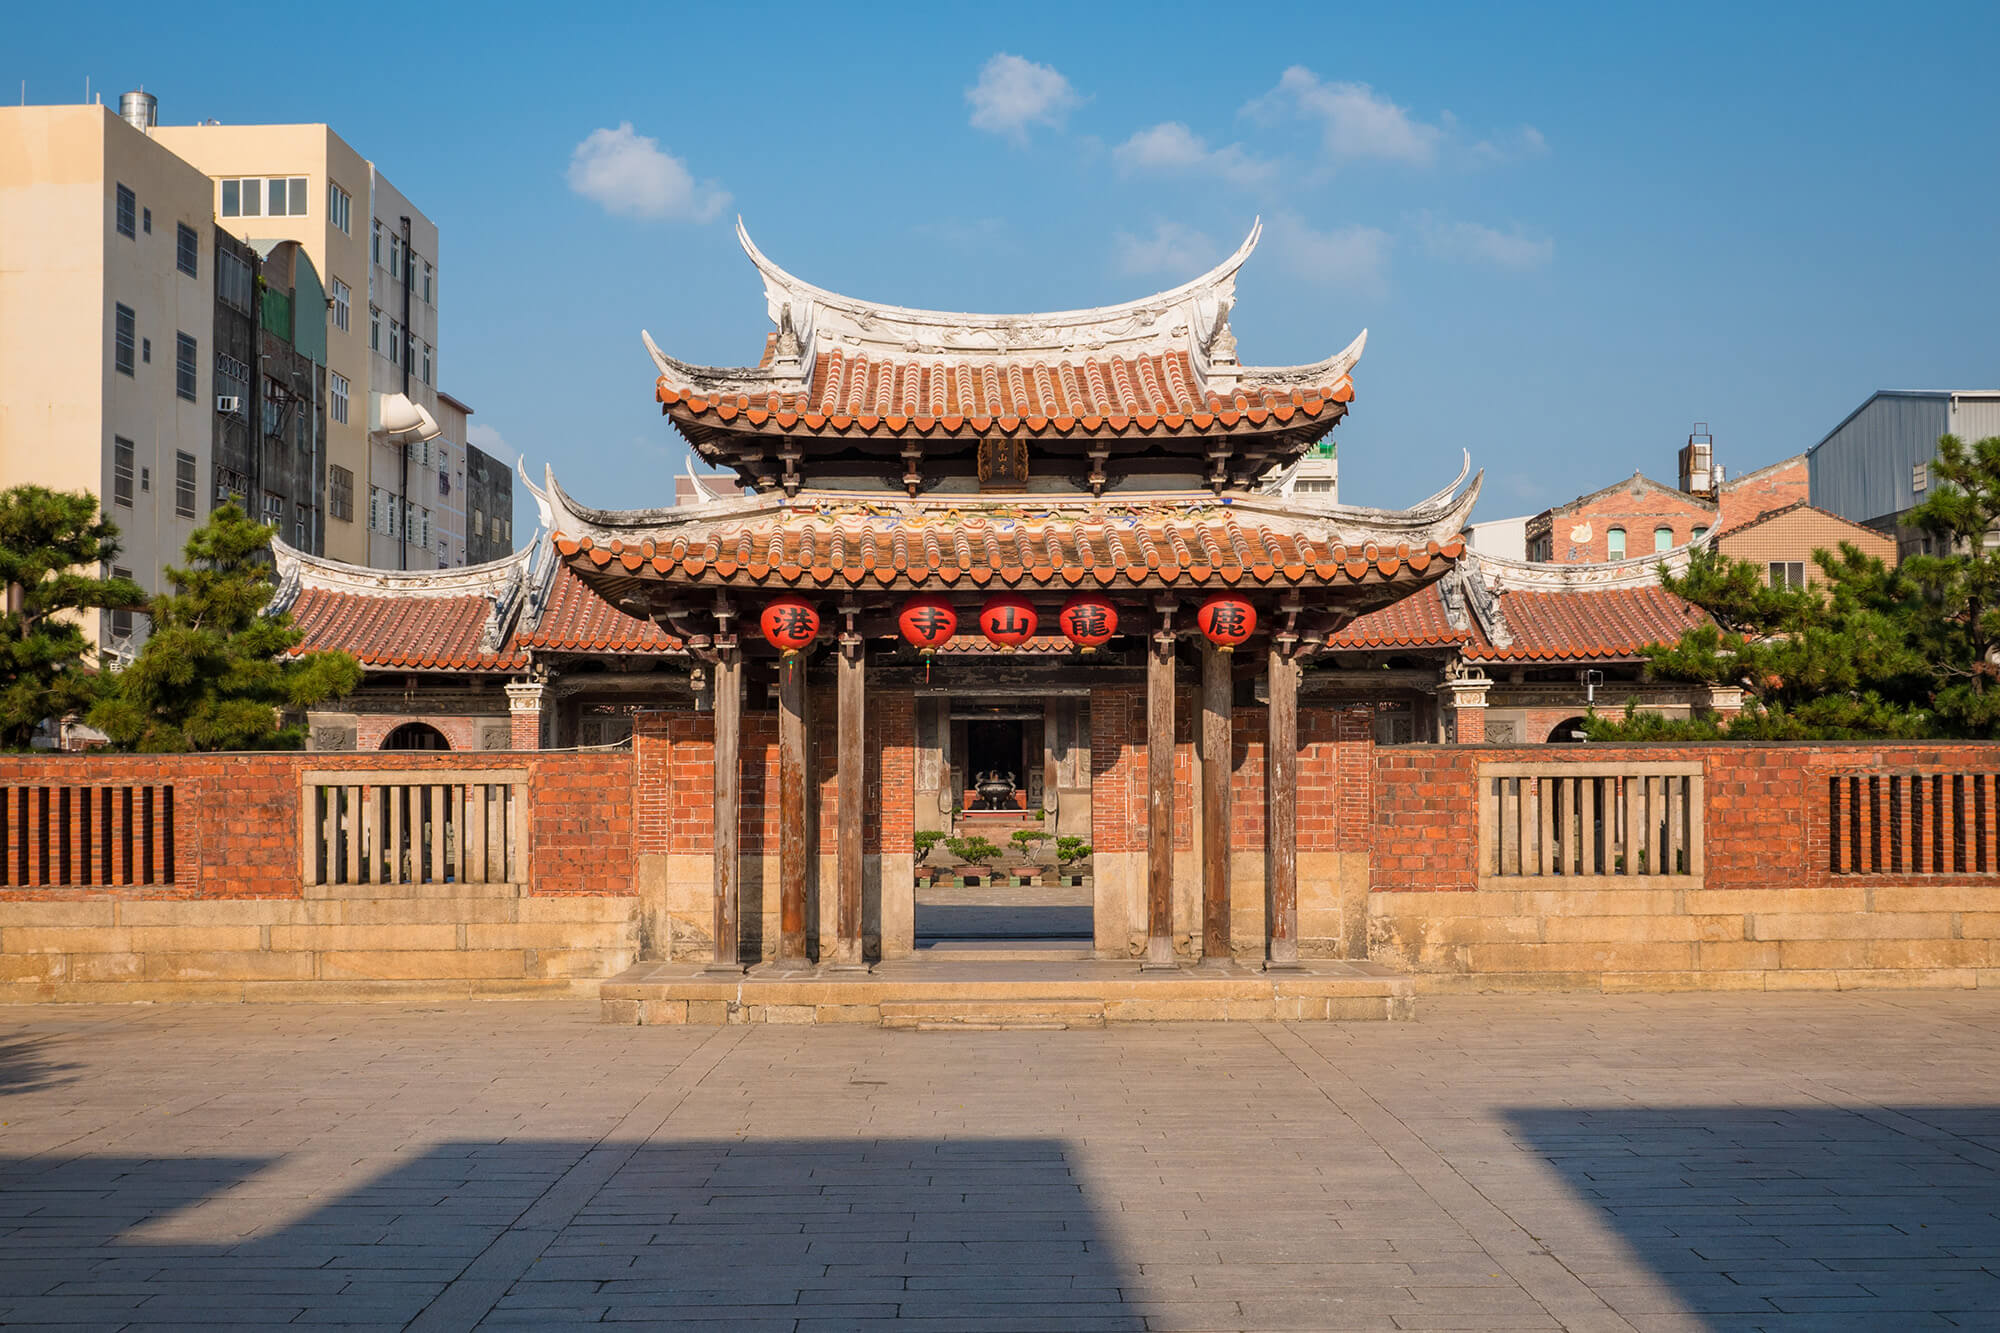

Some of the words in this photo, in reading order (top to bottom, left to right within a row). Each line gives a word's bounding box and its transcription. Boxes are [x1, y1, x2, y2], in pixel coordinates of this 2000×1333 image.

[772, 607, 814, 640] 港
[910, 607, 950, 640] 寺
[990, 607, 1029, 635] 山
[1068, 605, 1110, 637] 龍
[1208, 602, 1246, 637] 鹿
